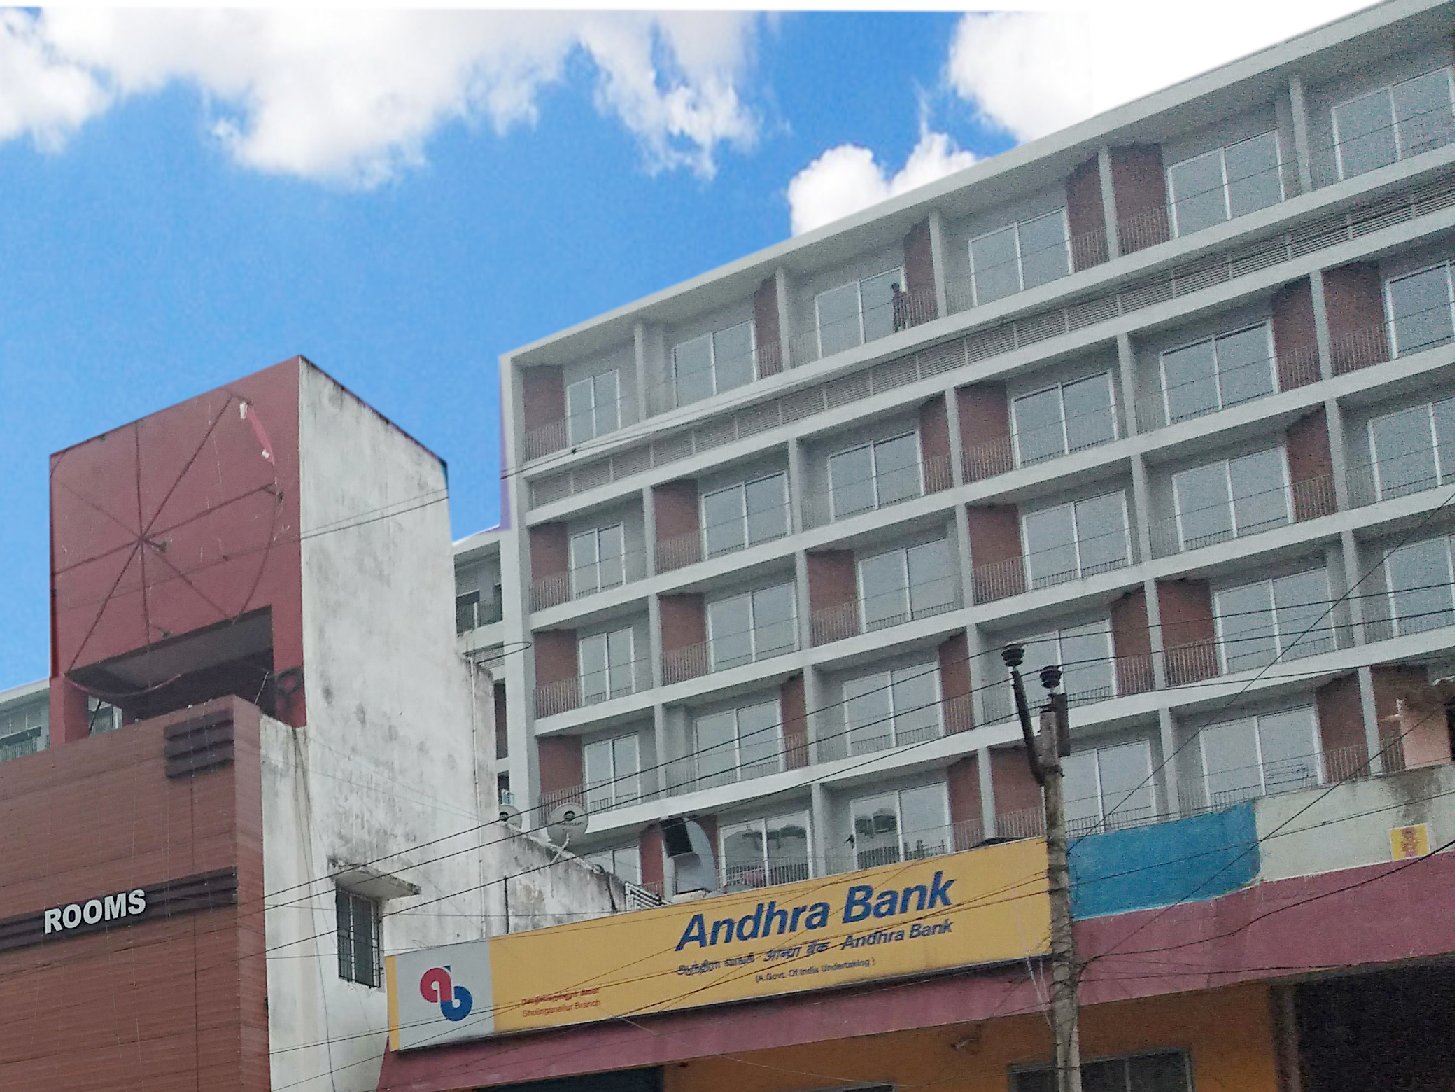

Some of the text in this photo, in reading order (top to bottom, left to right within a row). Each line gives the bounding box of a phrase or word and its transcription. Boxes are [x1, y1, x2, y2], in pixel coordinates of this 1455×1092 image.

[44, 889, 146, 933] ROOMS
[675, 870, 957, 951] Andhra Bank
[843, 919, 953, 950] Andhra Bank
